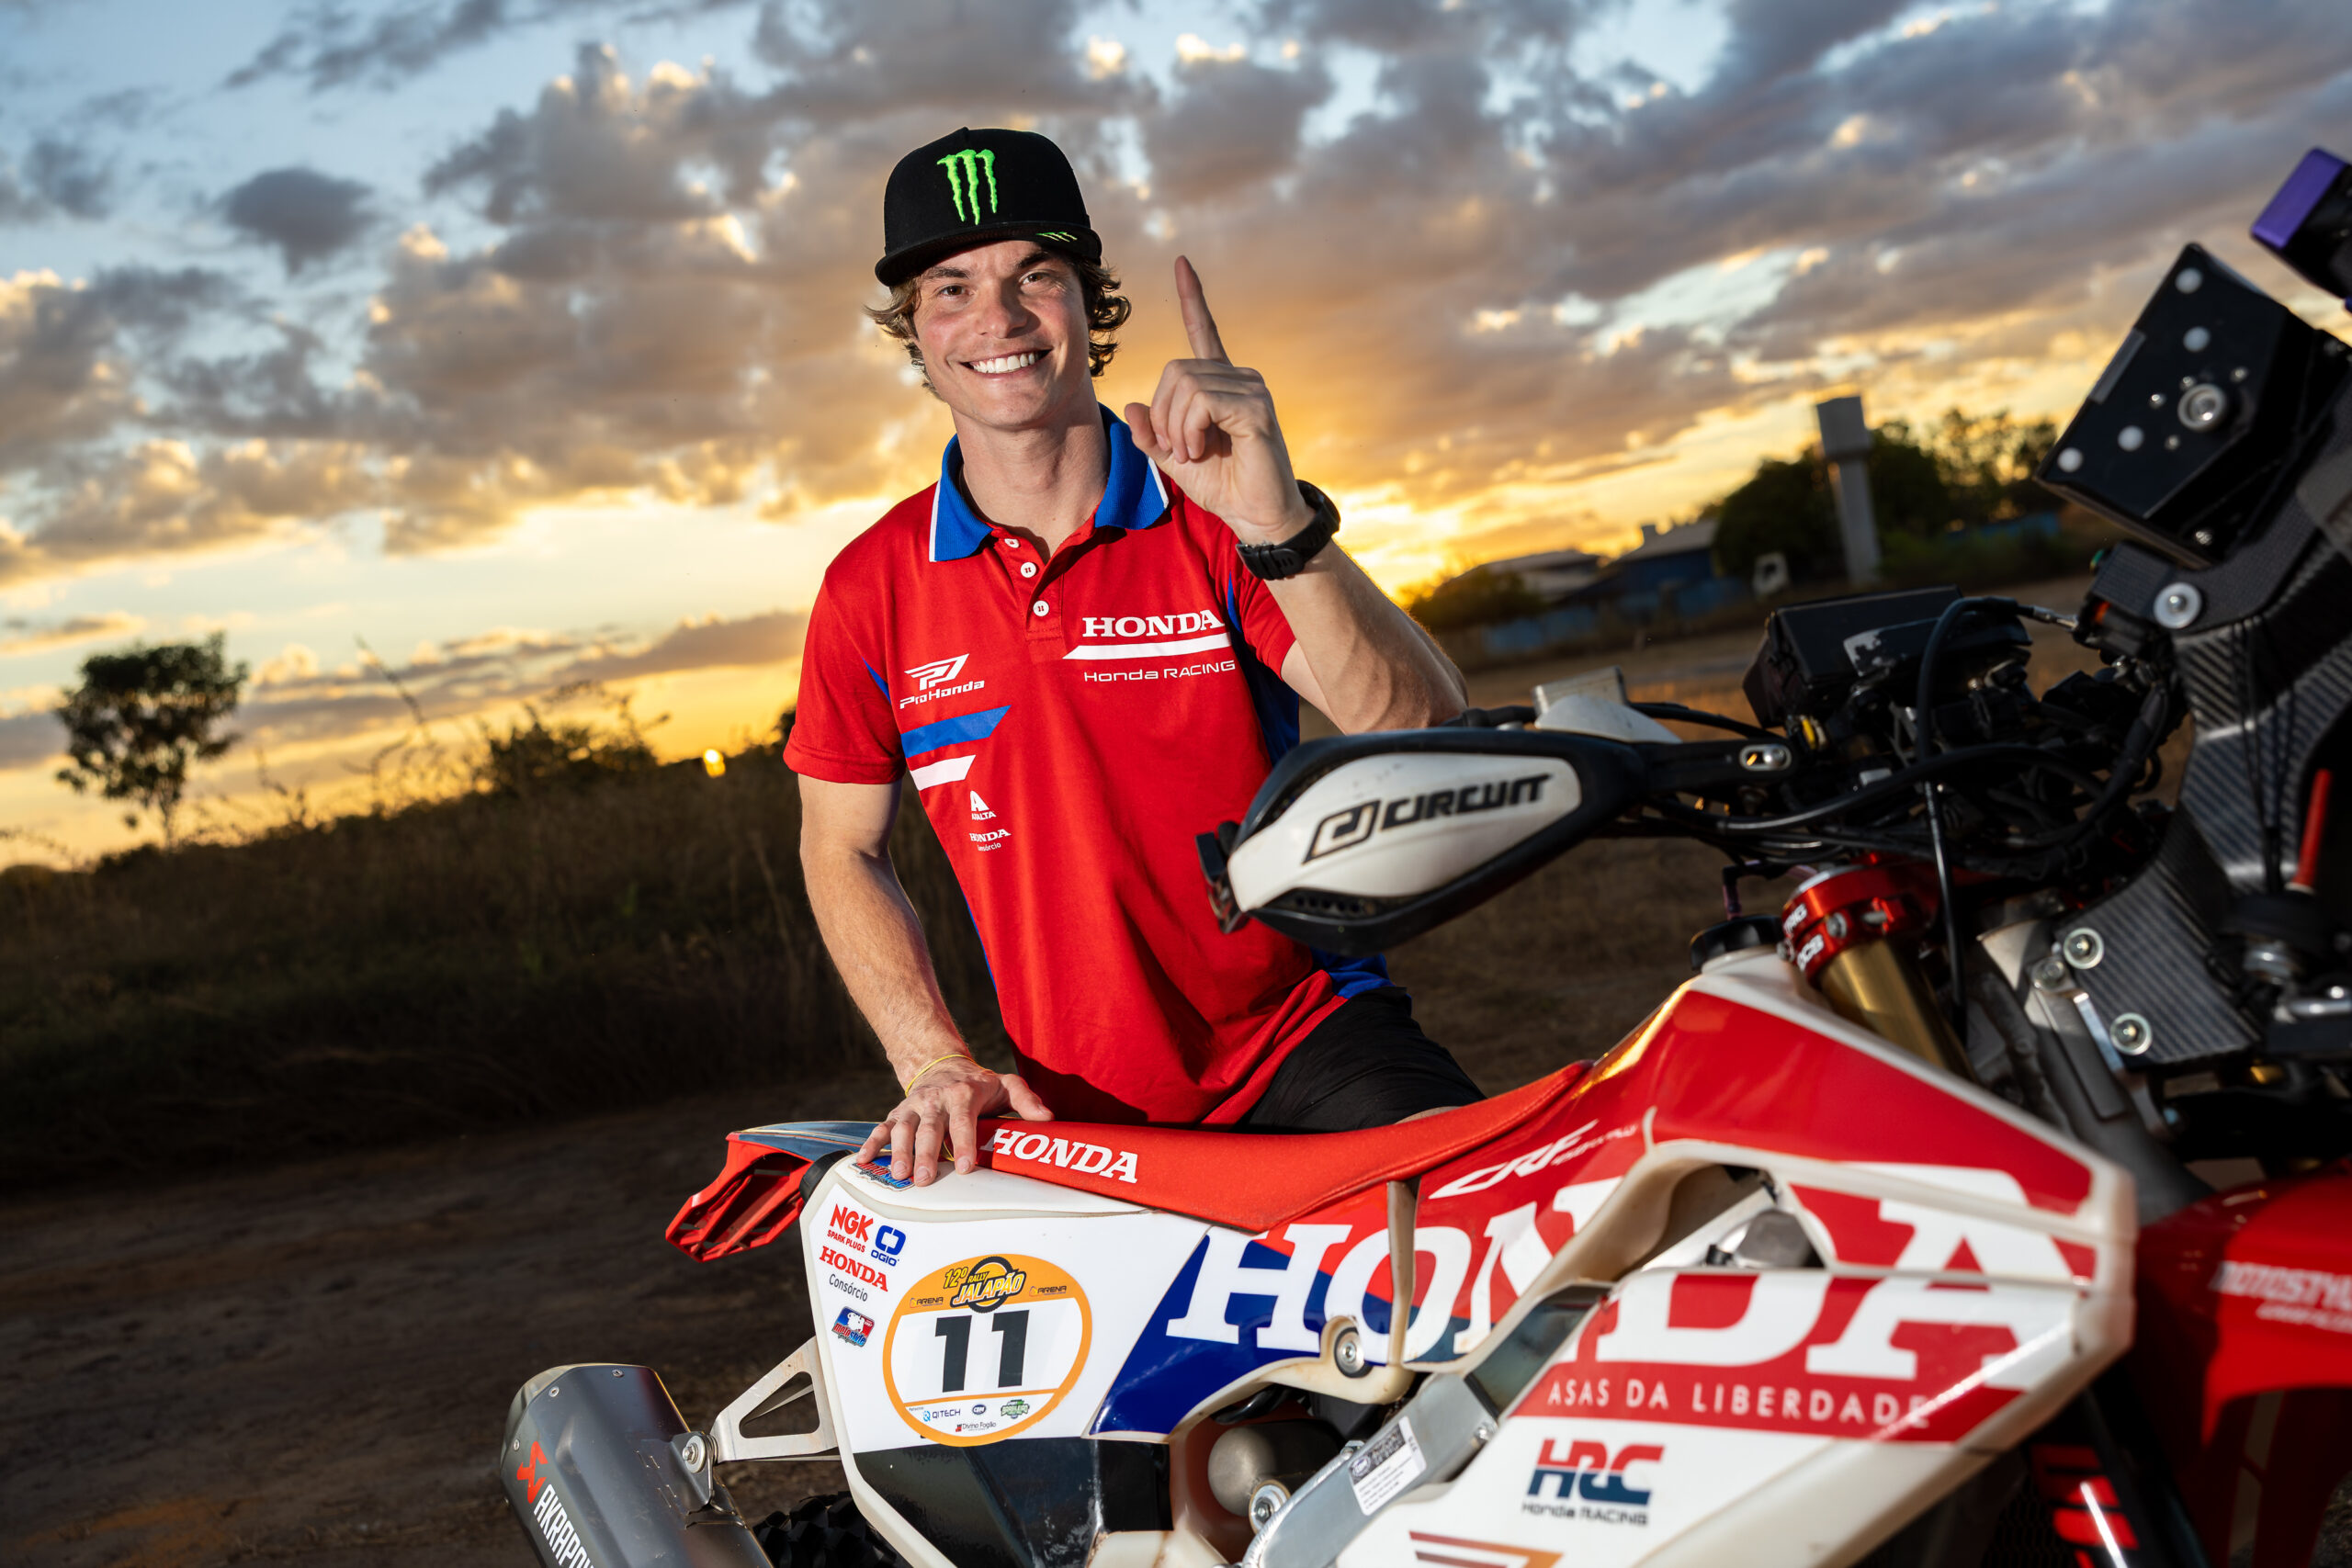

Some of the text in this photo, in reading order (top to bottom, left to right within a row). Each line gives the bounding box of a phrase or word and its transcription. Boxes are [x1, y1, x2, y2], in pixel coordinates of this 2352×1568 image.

[1082, 609, 1226, 637] HONDA
[1084, 660, 1237, 682] Honda RACING
[899, 680, 985, 710] ProHonda
[1382, 773, 1554, 830] CIRCUIT
[979, 1128, 1138, 1184] HONDA
[1428, 1119, 1600, 1200] CRF
[830, 1203, 873, 1243] NGK
[827, 1229, 865, 1253] SPARK PLUGS
[820, 1246, 888, 1292] HONDA
[870, 1249, 897, 1267] OGIO
[829, 1273, 868, 1303] Consórcio
[952, 1272, 1024, 1305] JALAPÃO
[967, 1271, 989, 1284] RALLY
[1036, 1285, 1068, 1294] ARENA
[916, 1296, 944, 1305] ARENA
[934, 1309, 1030, 1393] 11
[941, 1408, 961, 1418] TECH
[1547, 1378, 1929, 1429] ASAS DA LIBERDADE
[1527, 1438, 1665, 1506] HRC
[1521, 1501, 1576, 1519] Honda
[533, 1483, 595, 1568] AKRAPO
